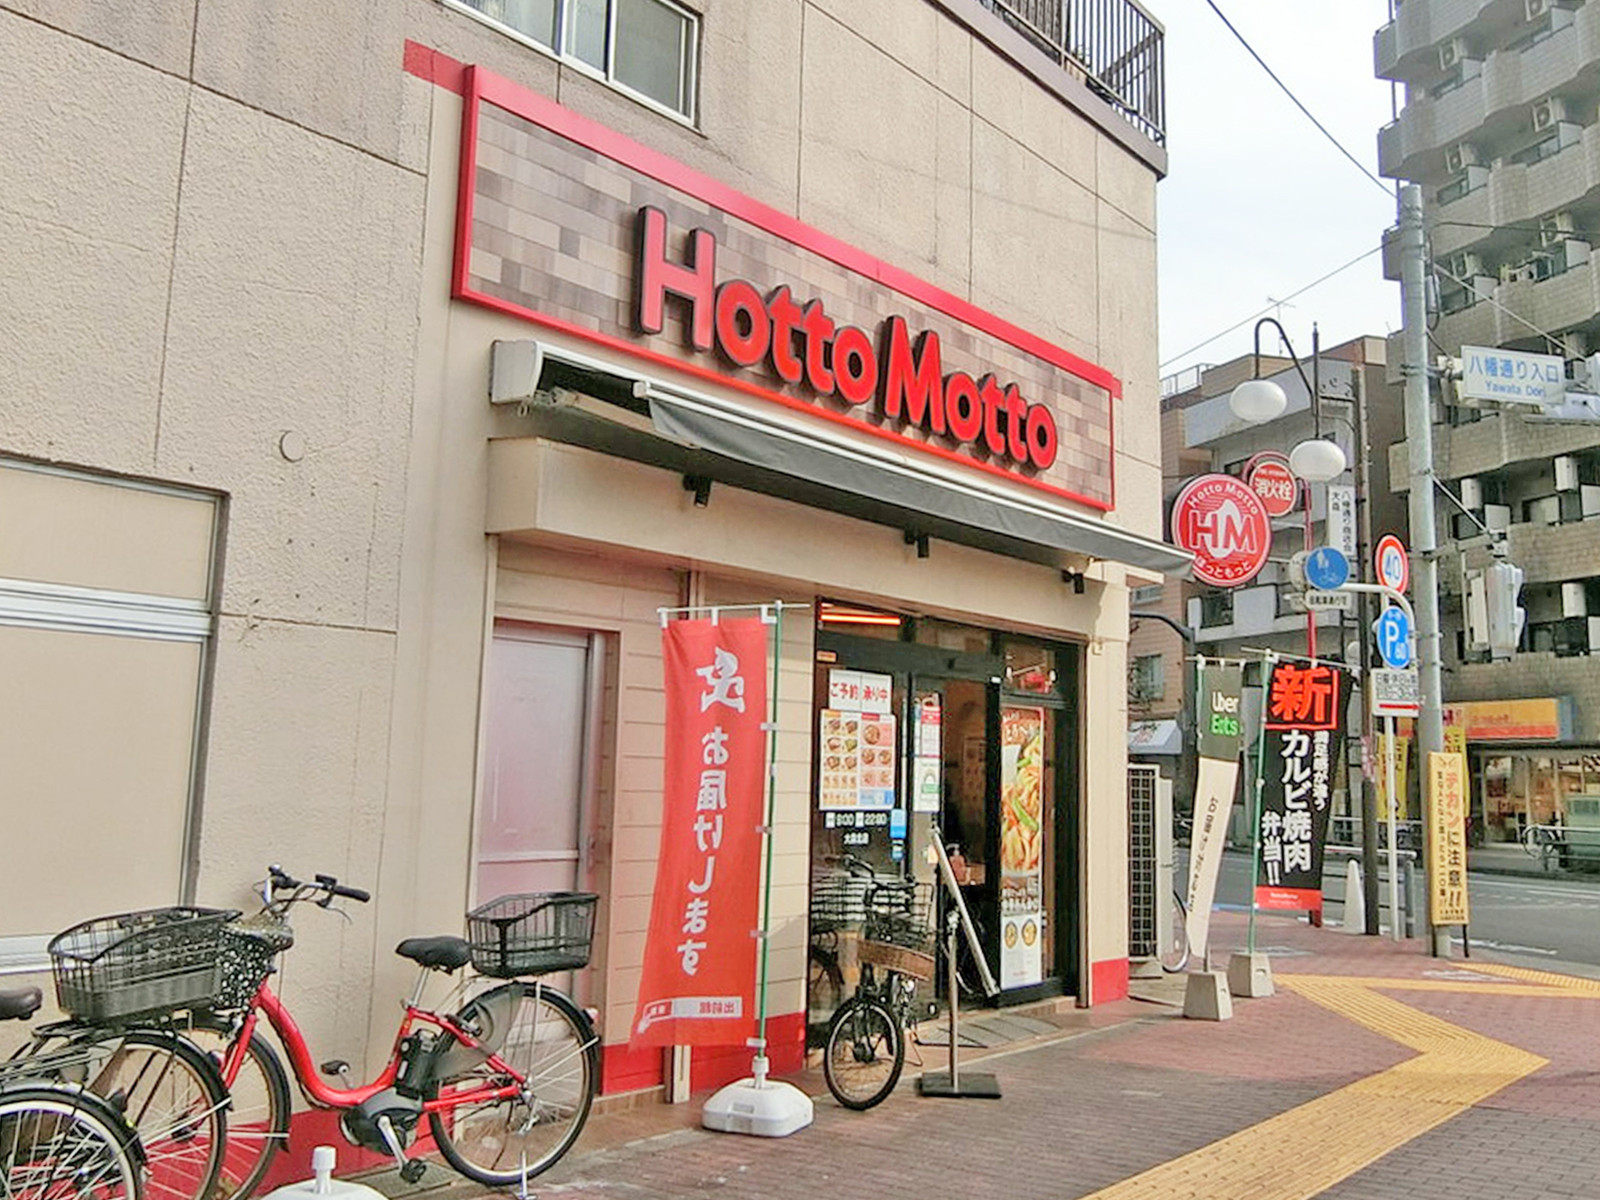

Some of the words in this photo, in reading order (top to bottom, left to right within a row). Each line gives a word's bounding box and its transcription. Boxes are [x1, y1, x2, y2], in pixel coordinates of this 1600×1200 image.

[638, 206, 877, 404] Hotto
[884, 315, 1058, 471] Motto
[1469, 355, 1559, 382] 八幡通り入口
[1485, 381, 1521, 394] Yawata
[1187, 484, 1222, 508] Hotto
[1225, 483, 1259, 515] Motto
[1254, 477, 1292, 502] 消火栓
[1189, 509, 1257, 554] HM
[1385, 555, 1400, 580] 40
[1385, 621, 1399, 659] P
[1212, 692, 1239, 713] Uber
[1271, 665, 1331, 722] 新
[1211, 716, 1239, 736] Eats
[1281, 729, 1313, 873] カルビ焼肉
